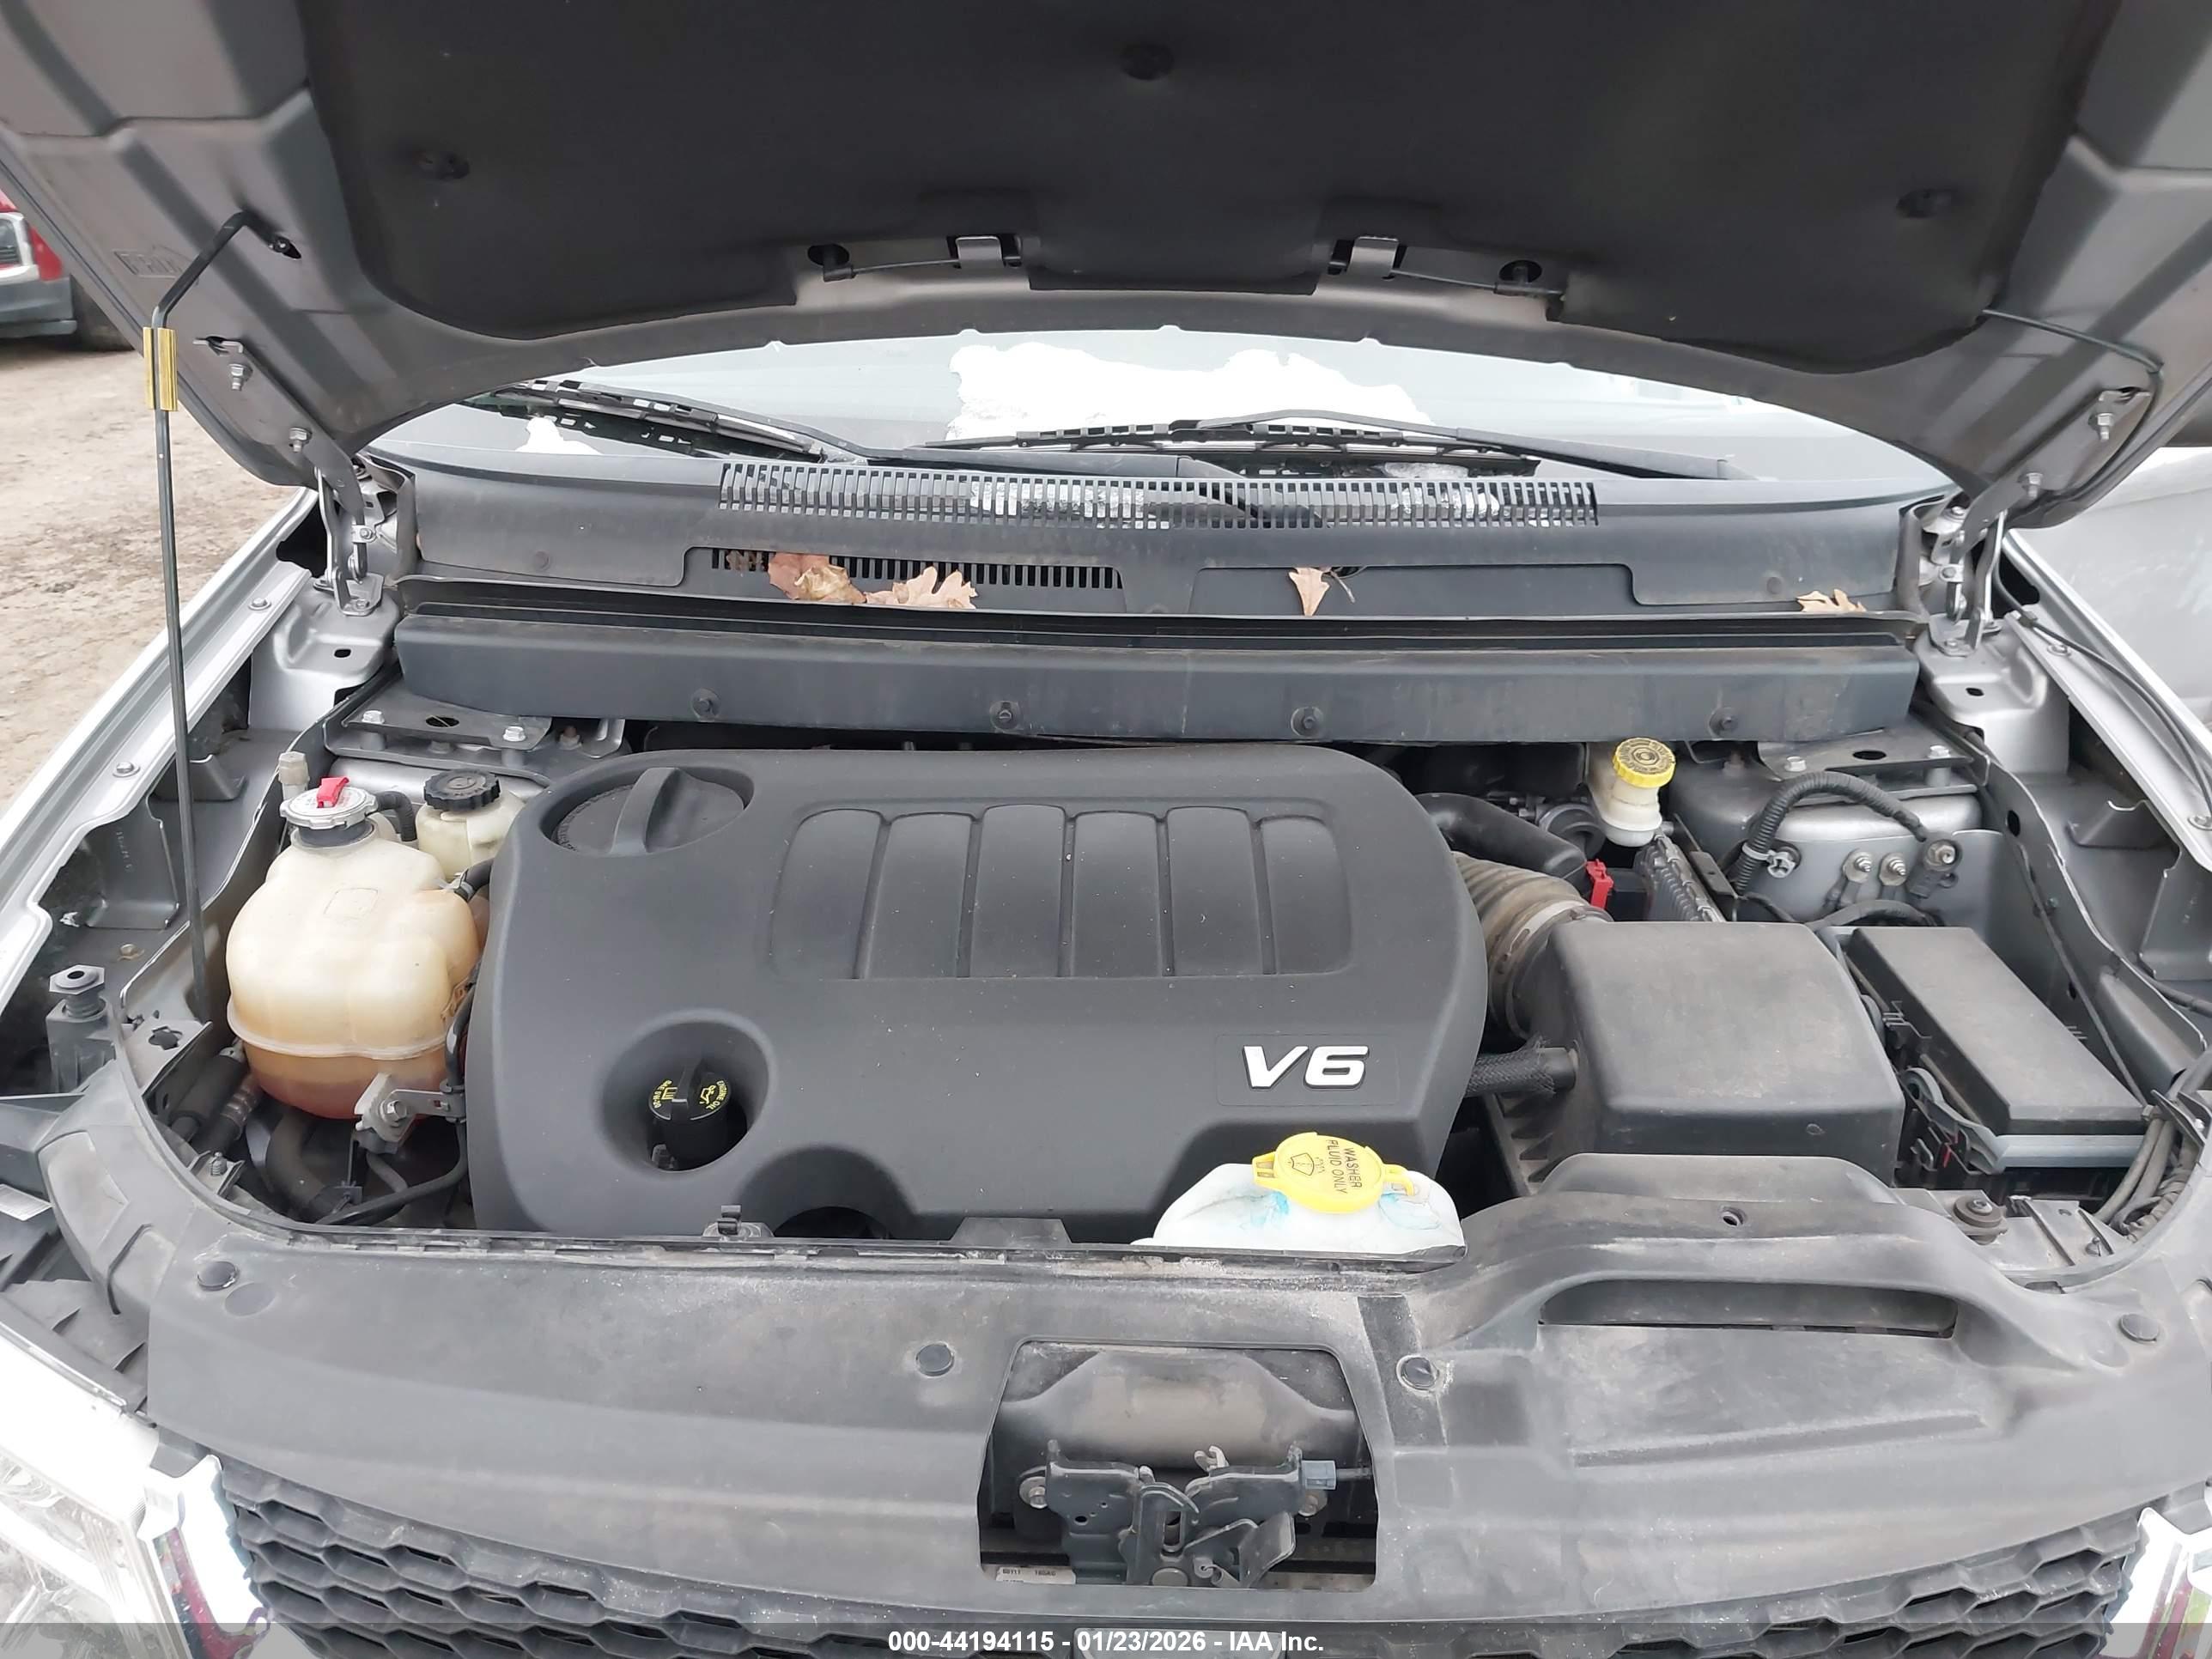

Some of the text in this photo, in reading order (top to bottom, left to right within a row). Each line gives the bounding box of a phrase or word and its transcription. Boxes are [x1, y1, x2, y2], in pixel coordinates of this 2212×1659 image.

[1243, 1046, 1370, 1089] V6
[706, 1080, 727, 1110] ENGINE OIL
[1326, 1139, 1348, 1194] FLUID ONLY
[1344, 1147, 1363, 1188] WASHER
